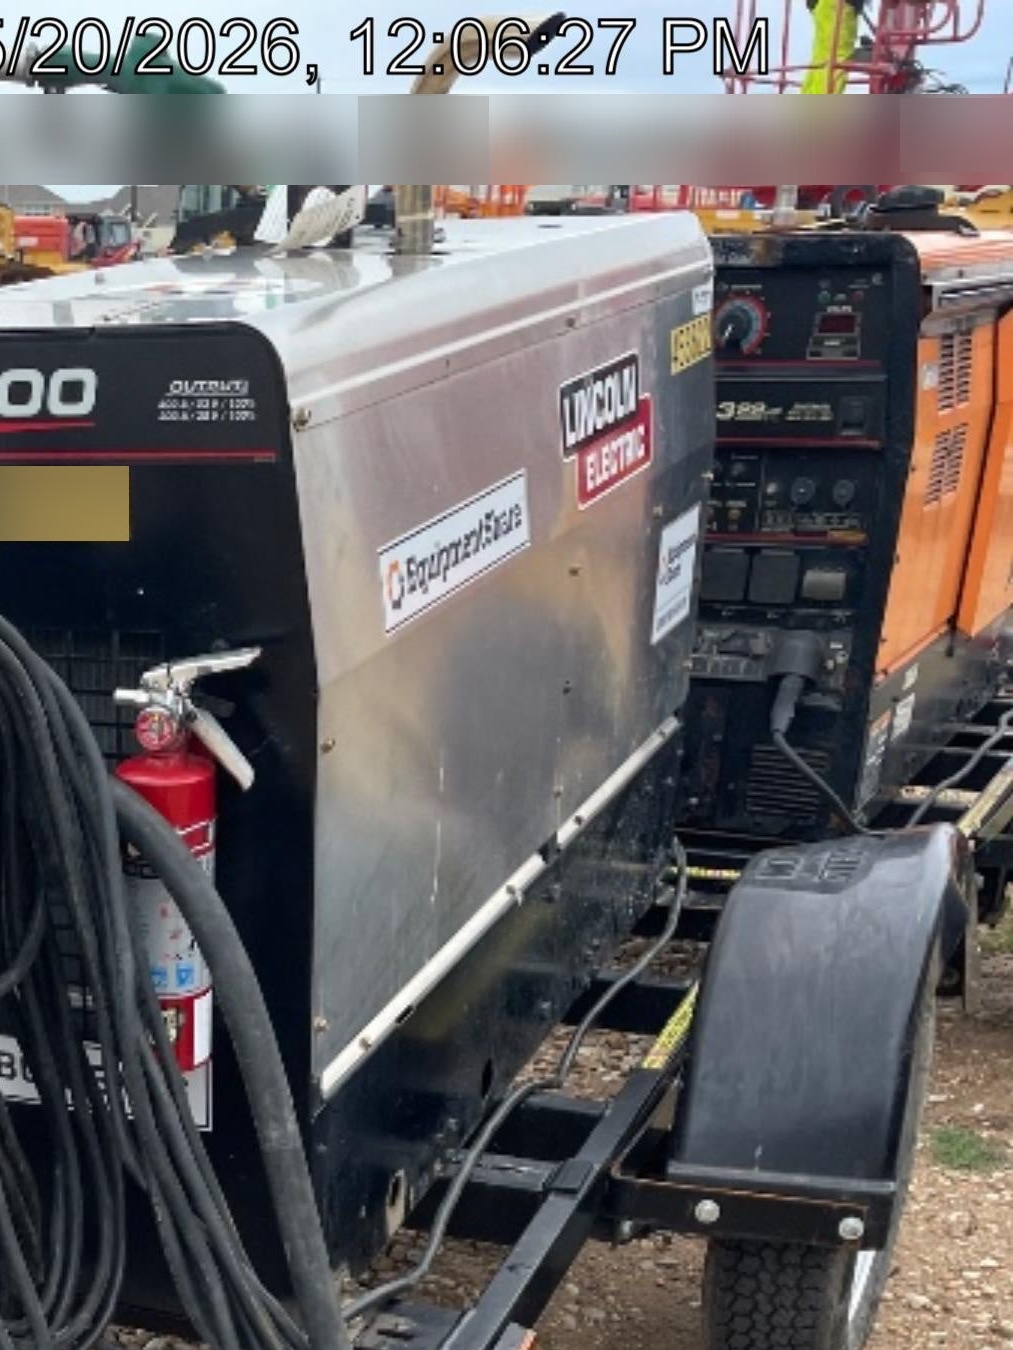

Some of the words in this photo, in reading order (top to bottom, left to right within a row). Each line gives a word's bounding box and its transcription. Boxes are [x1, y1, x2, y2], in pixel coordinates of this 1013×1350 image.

[562, 362, 637, 448] LINCOLN
[585, 422, 646, 493] ELECTRIC
[405, 503, 523, 595] EquipmentShare
